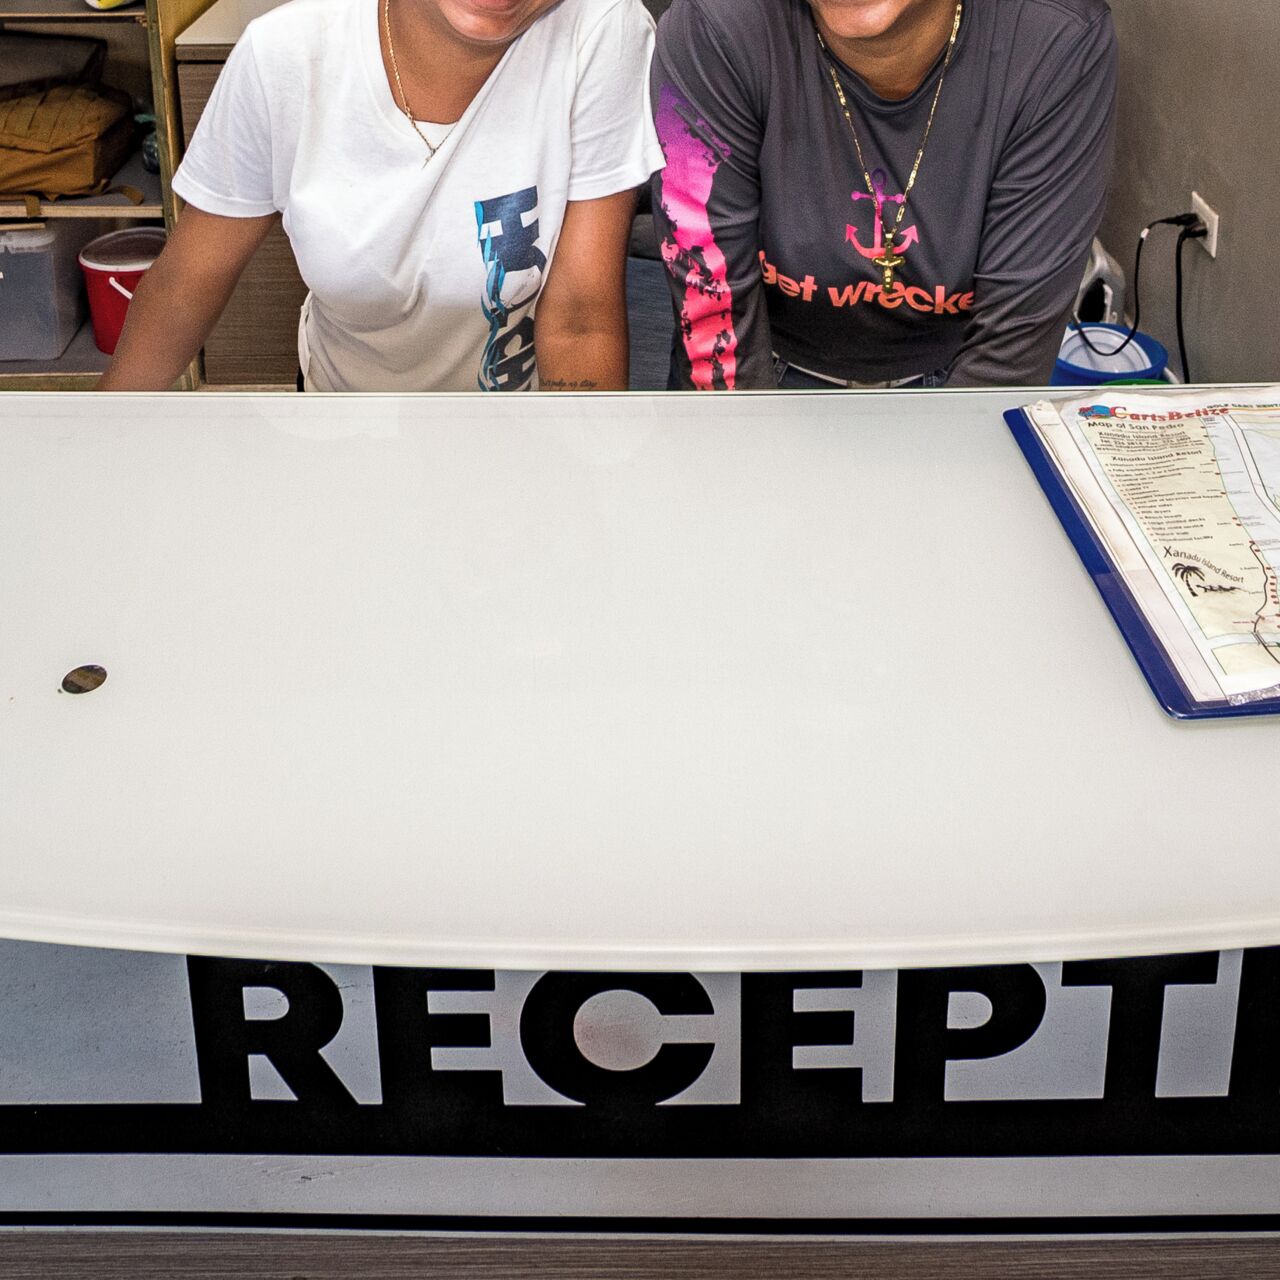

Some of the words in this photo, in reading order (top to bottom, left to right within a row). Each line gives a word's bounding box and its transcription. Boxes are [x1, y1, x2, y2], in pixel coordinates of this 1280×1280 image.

[1164, 546, 1201, 562] Xanadu
[1201, 558, 1220, 574] Island
[1220, 570, 1244, 583] Resort
